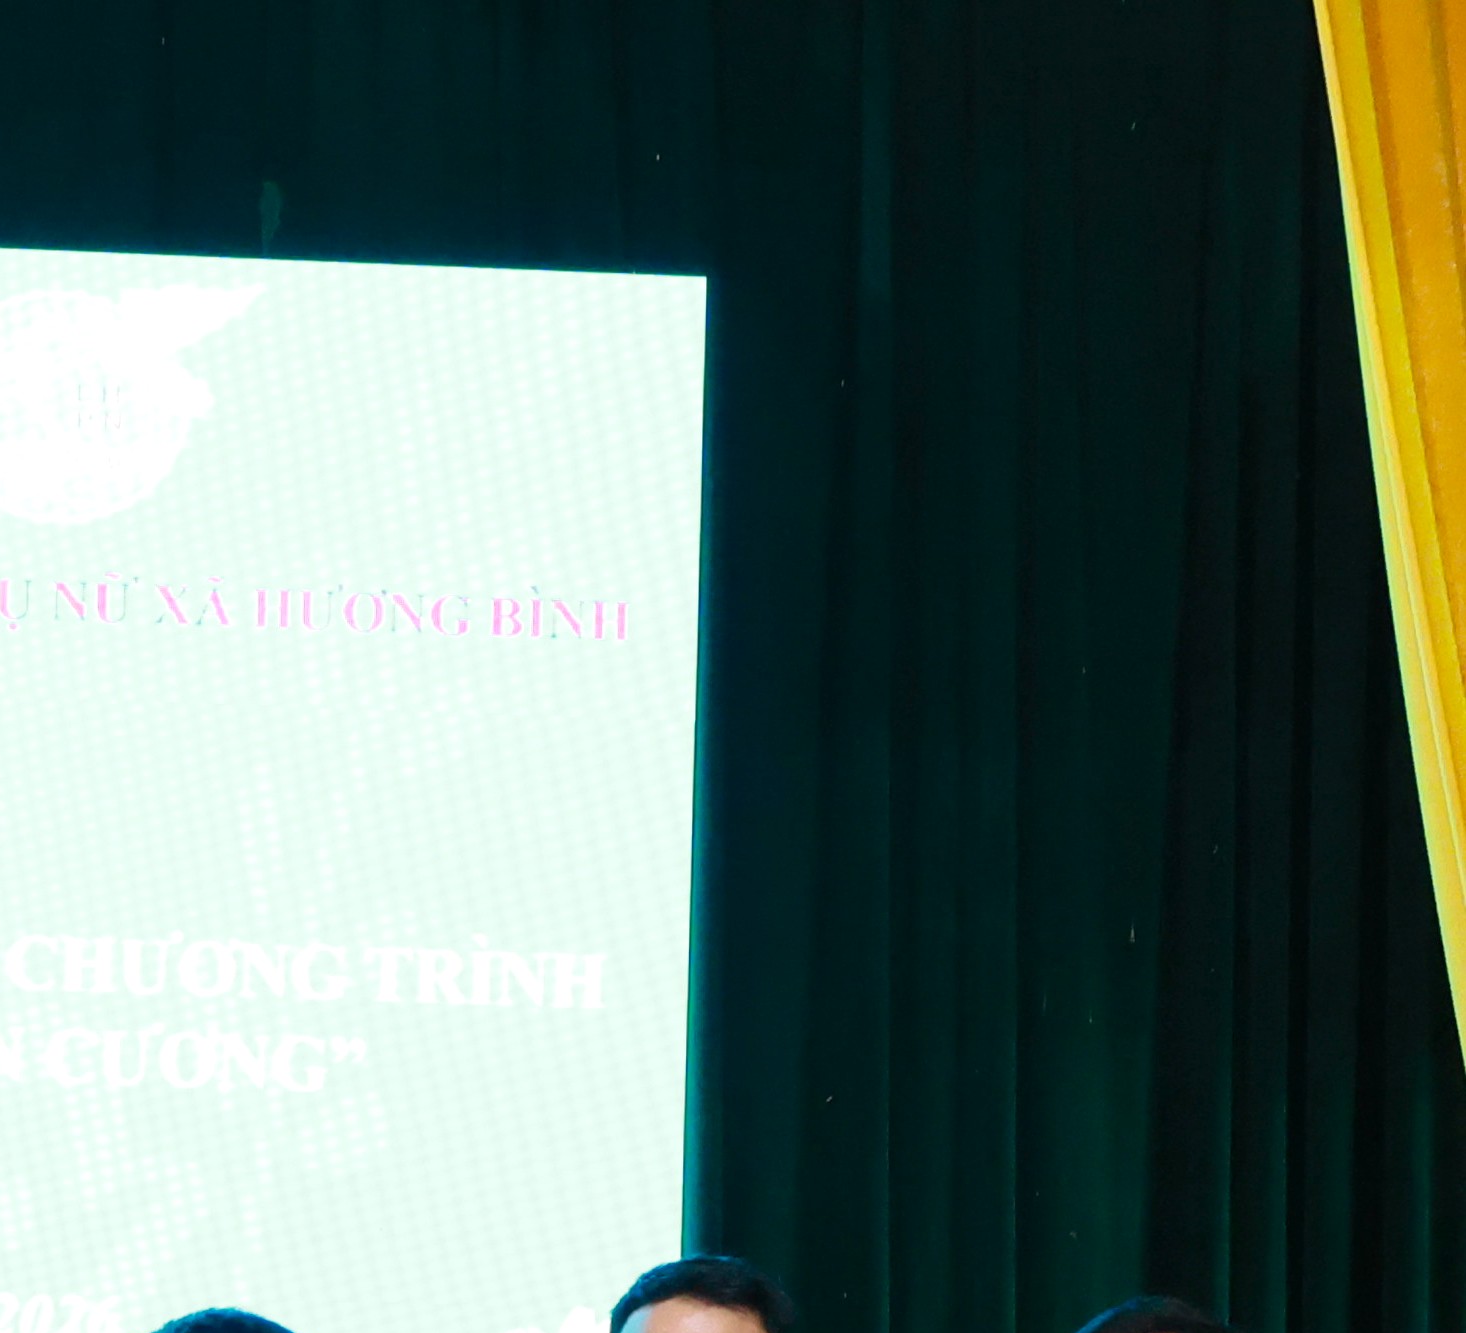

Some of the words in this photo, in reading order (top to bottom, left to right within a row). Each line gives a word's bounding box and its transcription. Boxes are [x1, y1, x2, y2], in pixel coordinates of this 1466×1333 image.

[153, 575, 231, 626] XÃ
[254, 583, 471, 637] HƯƠNG
[490, 585, 630, 641] BÌNH
[3, 928, 353, 1003] CHƯƠNG
[363, 931, 609, 1011] TRÌNH
